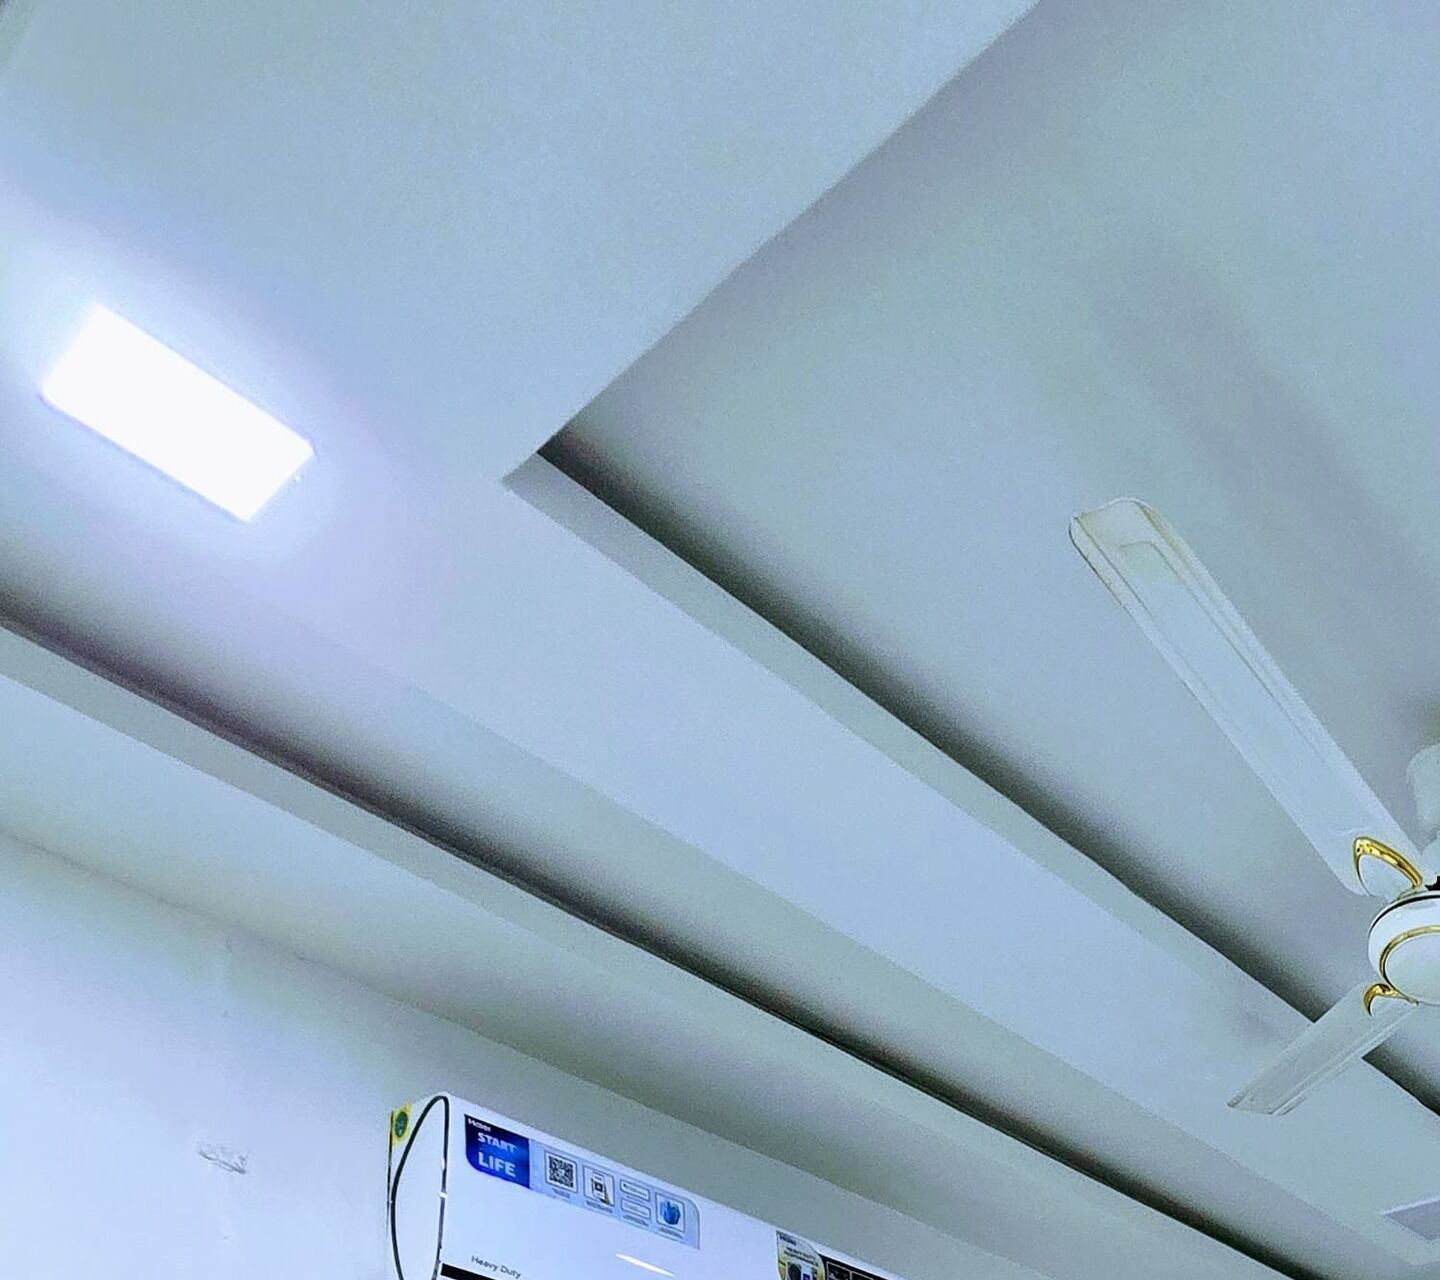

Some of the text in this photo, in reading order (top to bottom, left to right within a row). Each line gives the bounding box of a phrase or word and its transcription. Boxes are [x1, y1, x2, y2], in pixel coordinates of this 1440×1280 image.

[477, 1132, 517, 1153] START
[478, 1151, 516, 1178] LIFE
[471, 1255, 521, 1279] Heavy Duty
